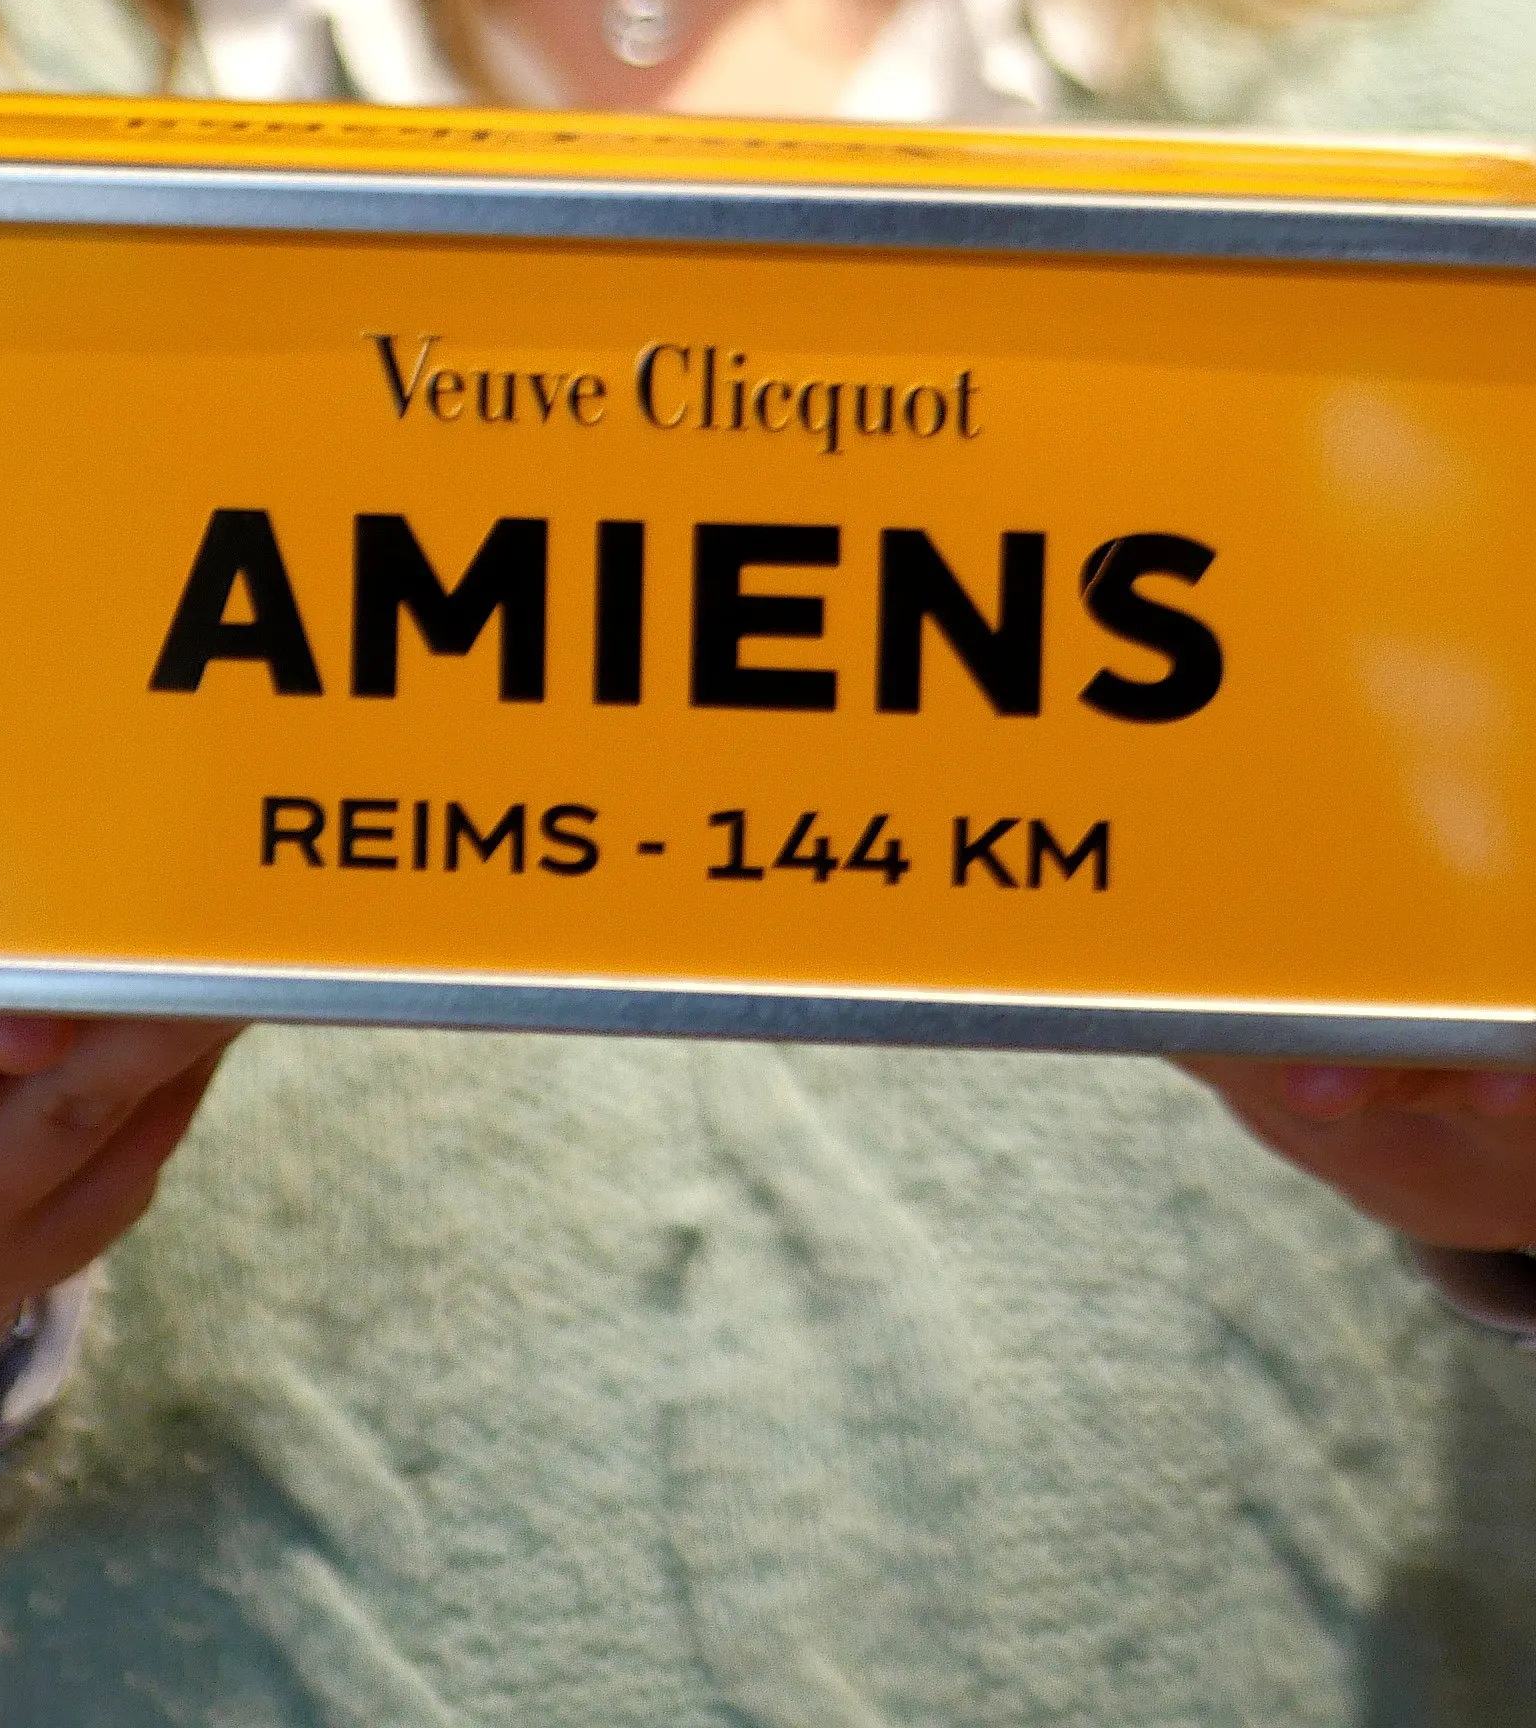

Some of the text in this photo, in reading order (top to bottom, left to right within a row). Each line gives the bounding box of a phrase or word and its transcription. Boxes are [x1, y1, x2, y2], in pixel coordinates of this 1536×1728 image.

[362, 332, 982, 456] Veuve Clicquot
[147, 506, 1225, 725] AMIENS
[259, 794, 1112, 893] REIMS - 144 KM
